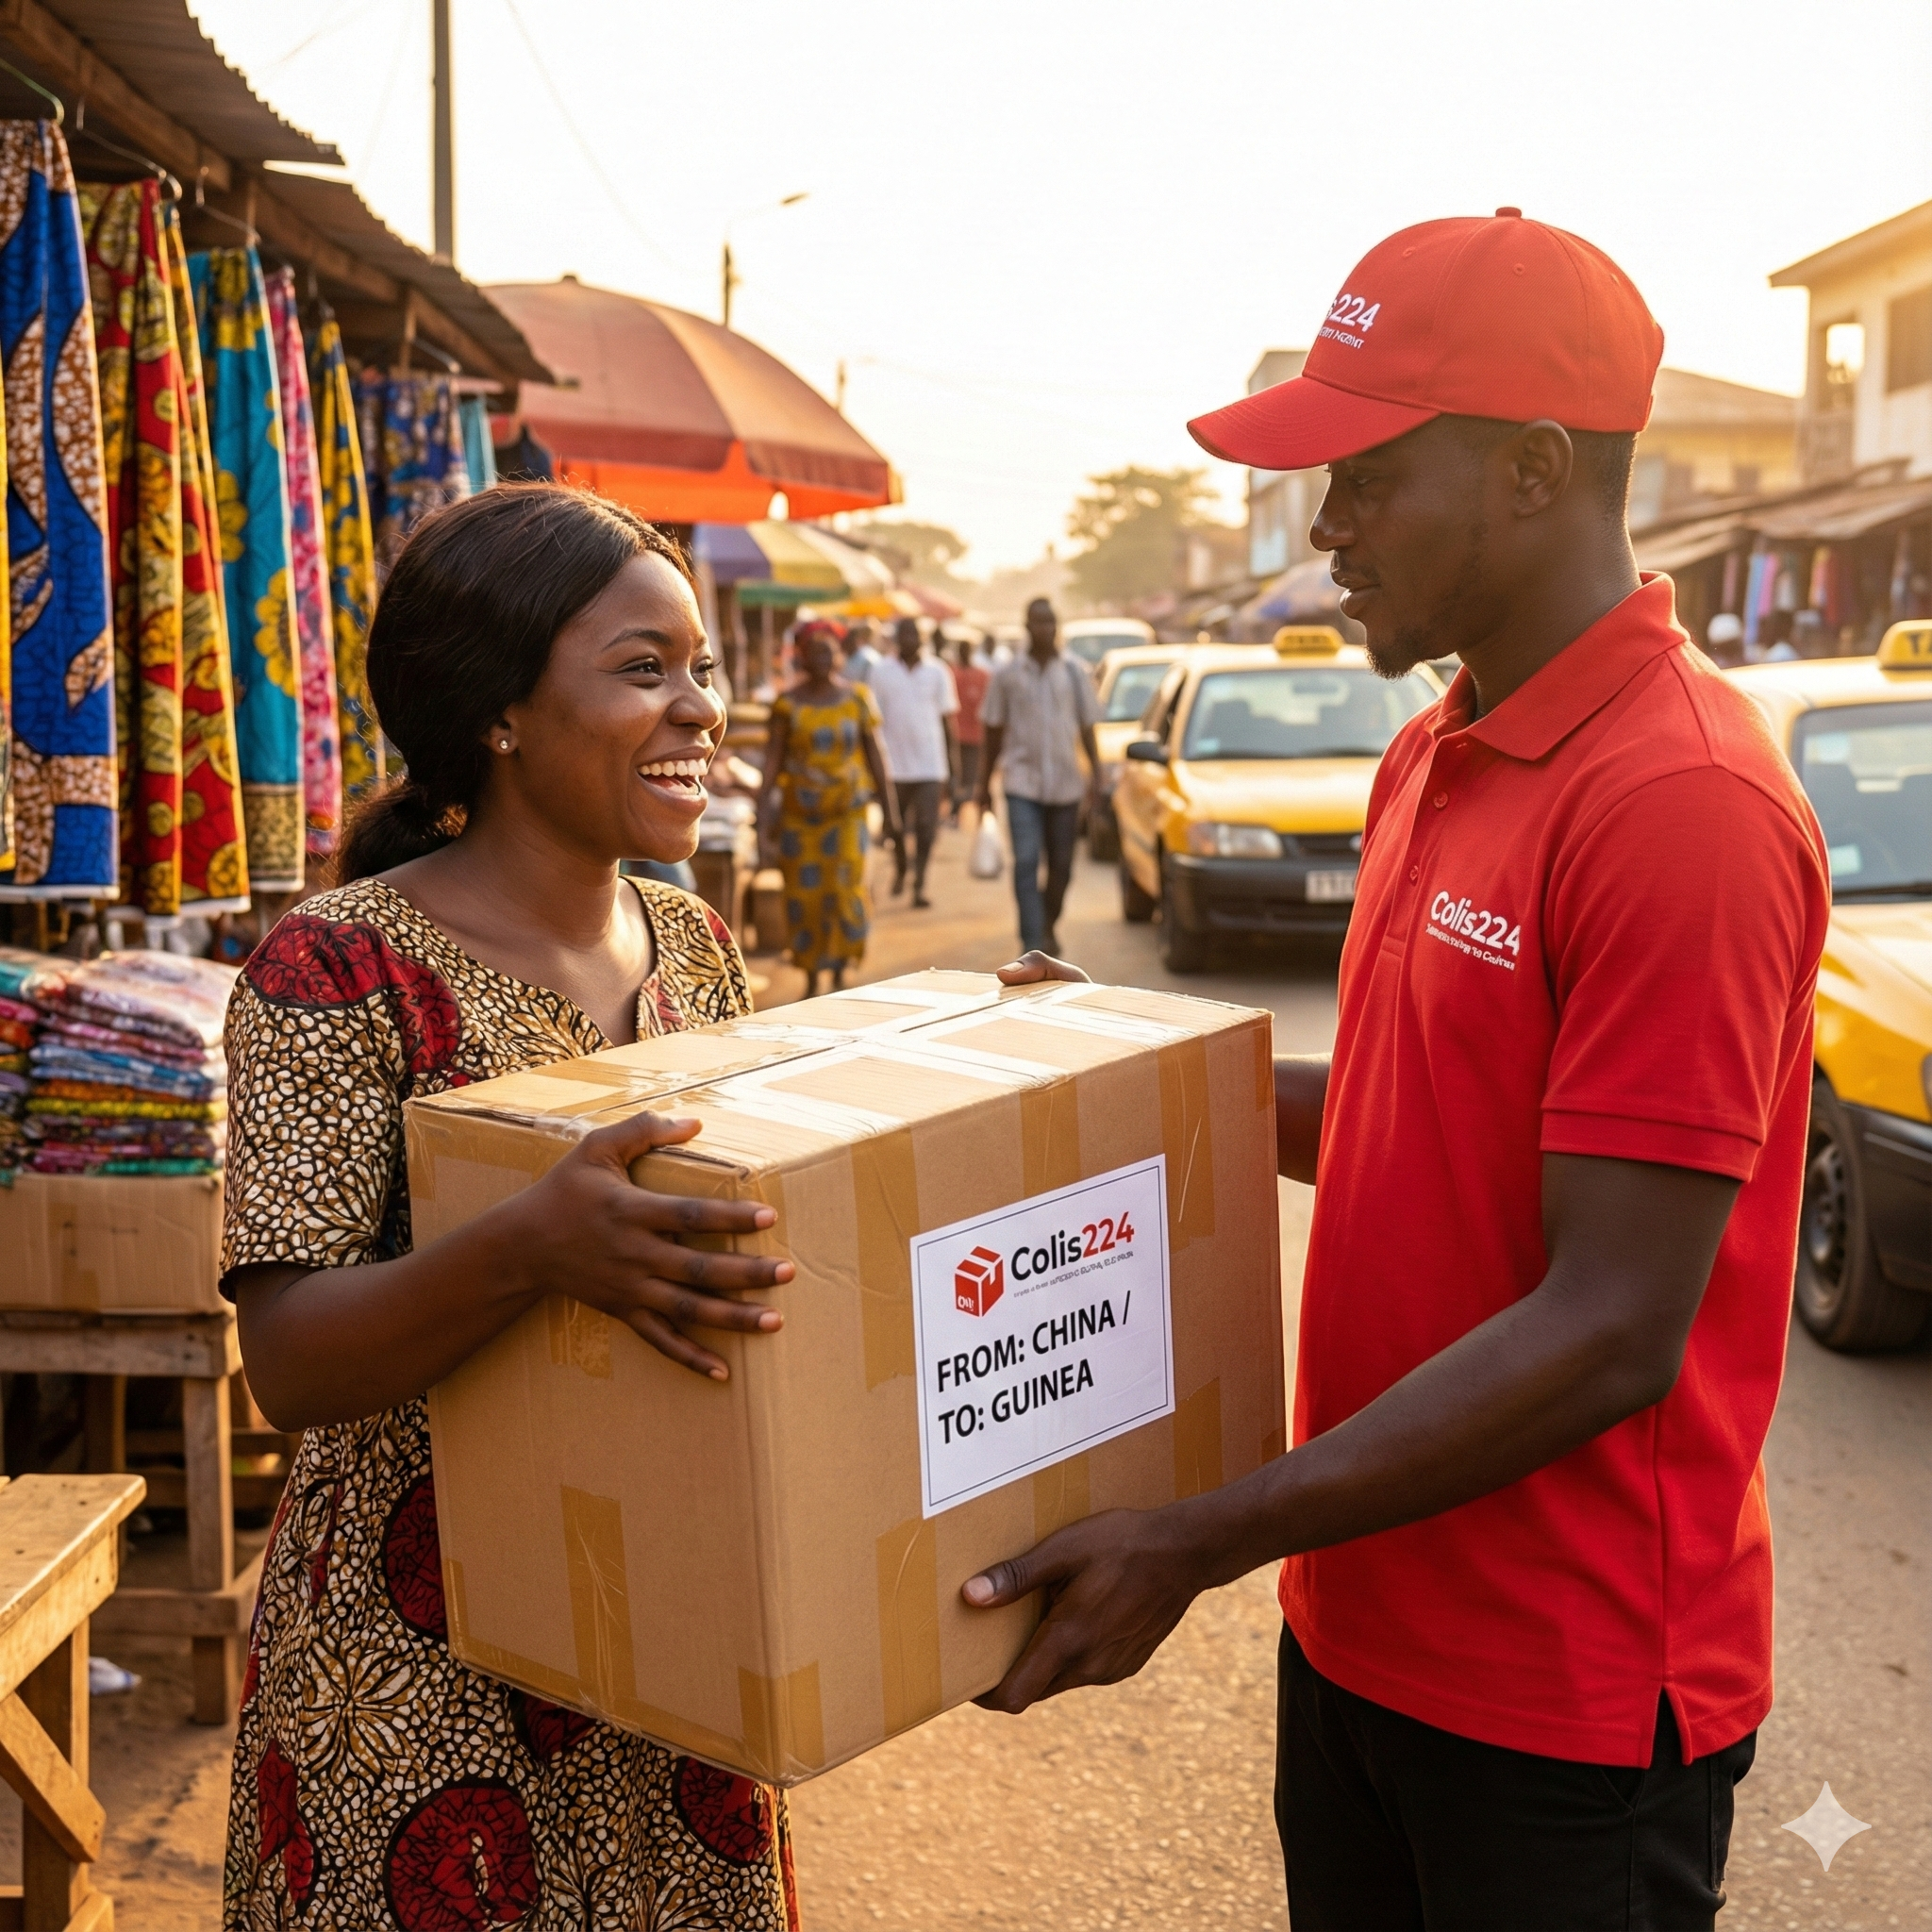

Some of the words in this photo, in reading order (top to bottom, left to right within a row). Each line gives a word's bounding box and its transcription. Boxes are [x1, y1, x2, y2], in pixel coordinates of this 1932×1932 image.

[1430, 891, 1522, 957] Colis224
[1010, 1211, 1135, 1281] Colis224
[937, 1334, 1025, 1393] FROM:
[1032, 1299, 1116, 1355] CHINA
[1122, 1290, 1131, 1325] /
[938, 1404, 985, 1444] TO:
[991, 1358, 1094, 1423] GUINEA
